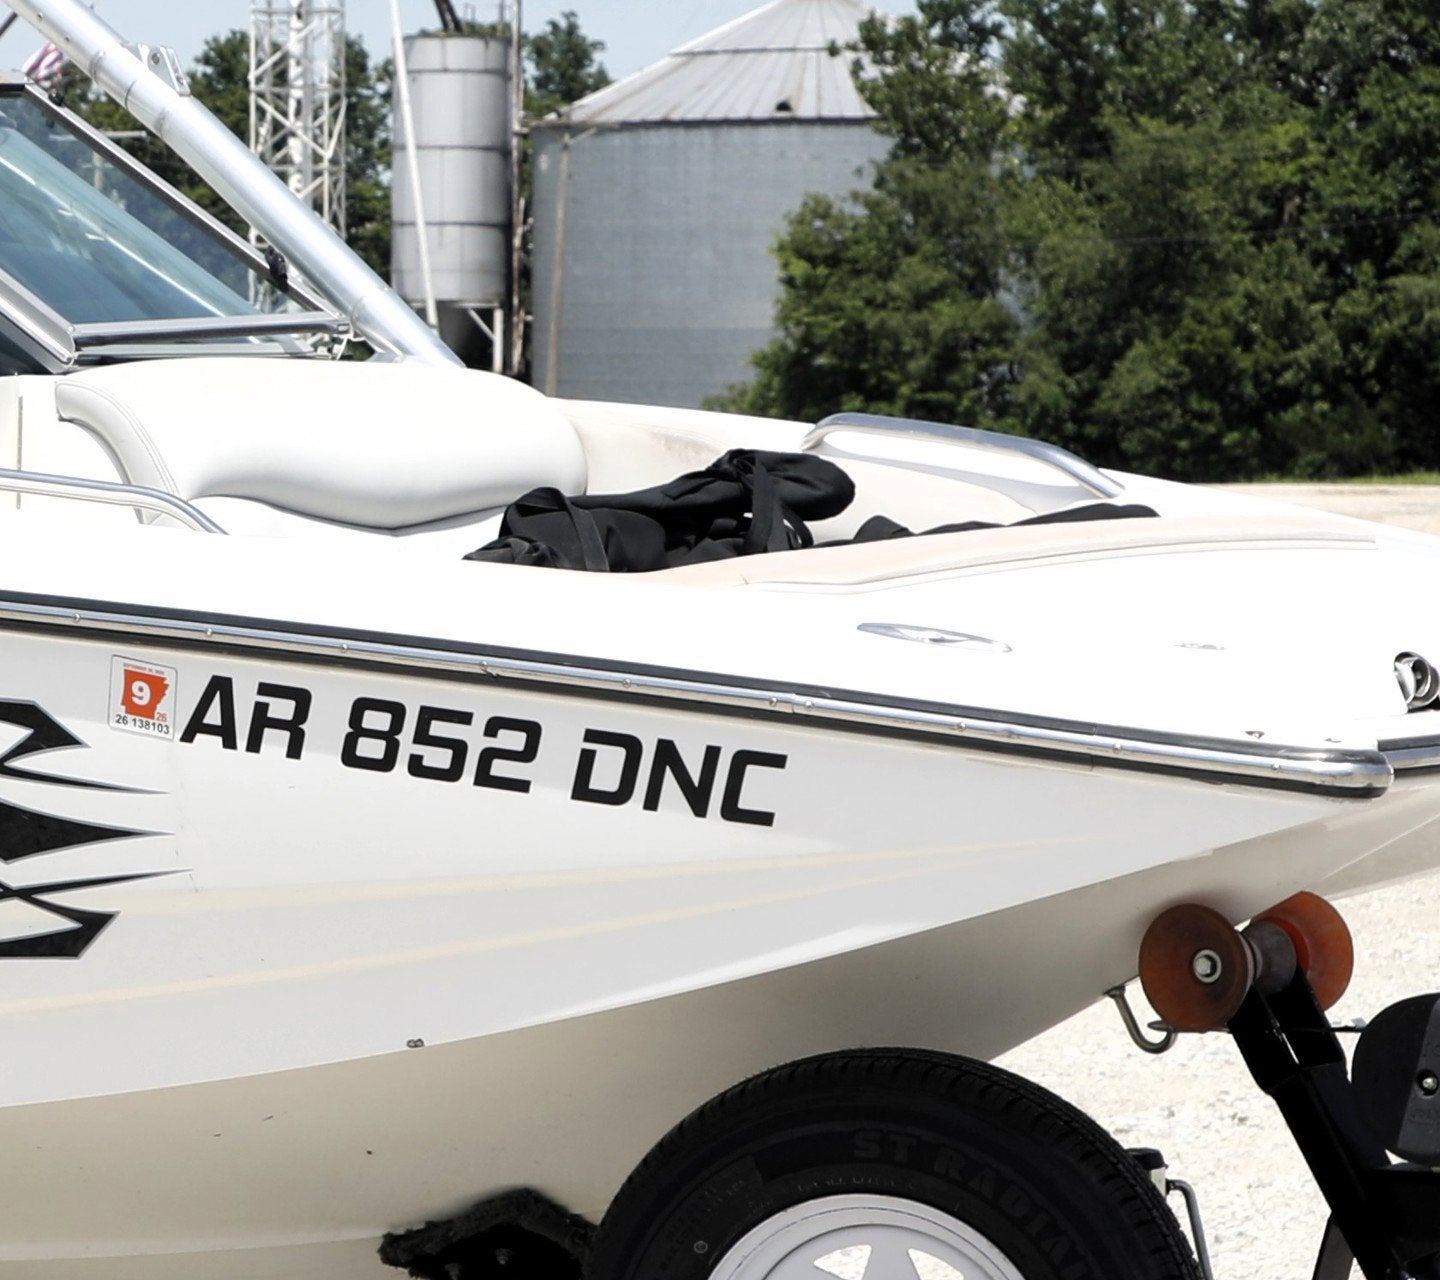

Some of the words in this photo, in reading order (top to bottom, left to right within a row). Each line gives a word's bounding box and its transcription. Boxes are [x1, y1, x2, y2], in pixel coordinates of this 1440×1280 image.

[131, 680, 151, 706] 9
[115, 714, 128, 725] 26
[132, 718, 170, 734] 138103
[179, 674, 312, 760] AR
[341, 696, 542, 794] 852
[570, 728, 788, 828] DNC
